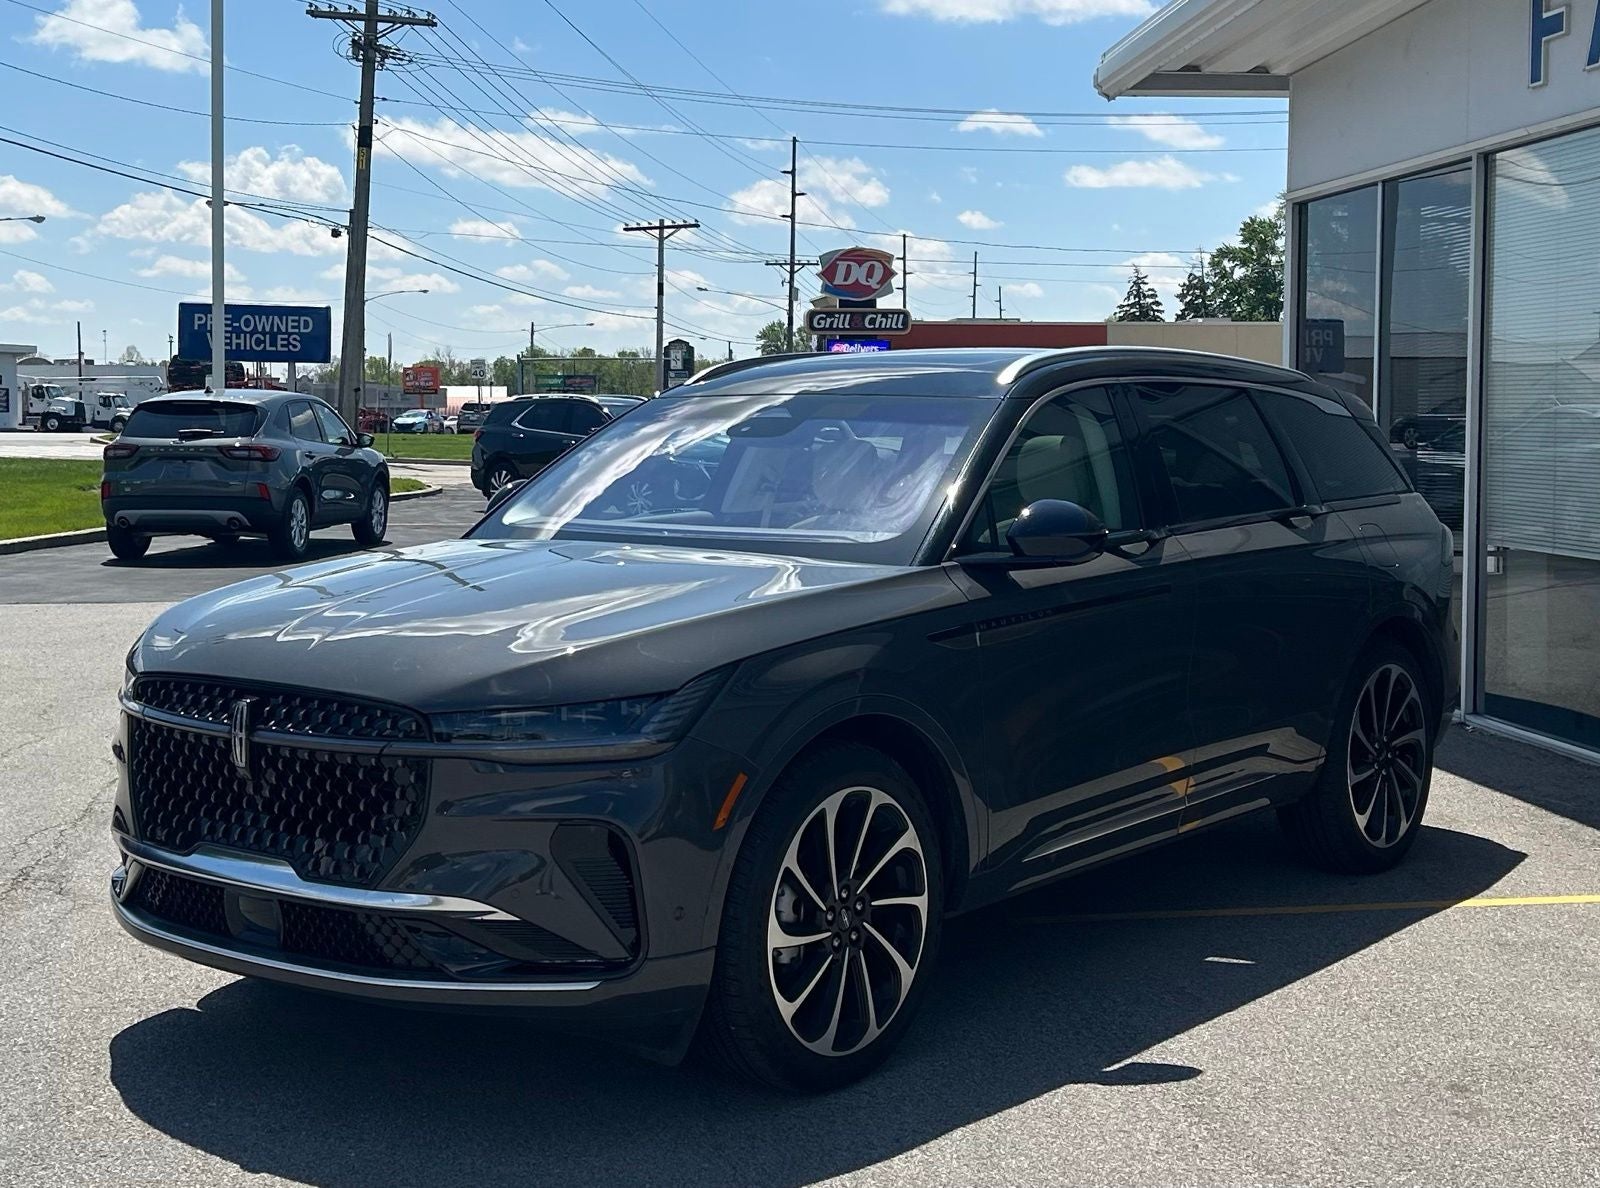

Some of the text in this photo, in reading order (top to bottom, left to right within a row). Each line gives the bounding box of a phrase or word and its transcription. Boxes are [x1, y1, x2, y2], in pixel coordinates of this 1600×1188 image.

[833, 260, 884, 289] DQ
[813, 313, 851, 329] Grill
[864, 313, 904, 329] Chill
[472, 370, 484, 378] 40
